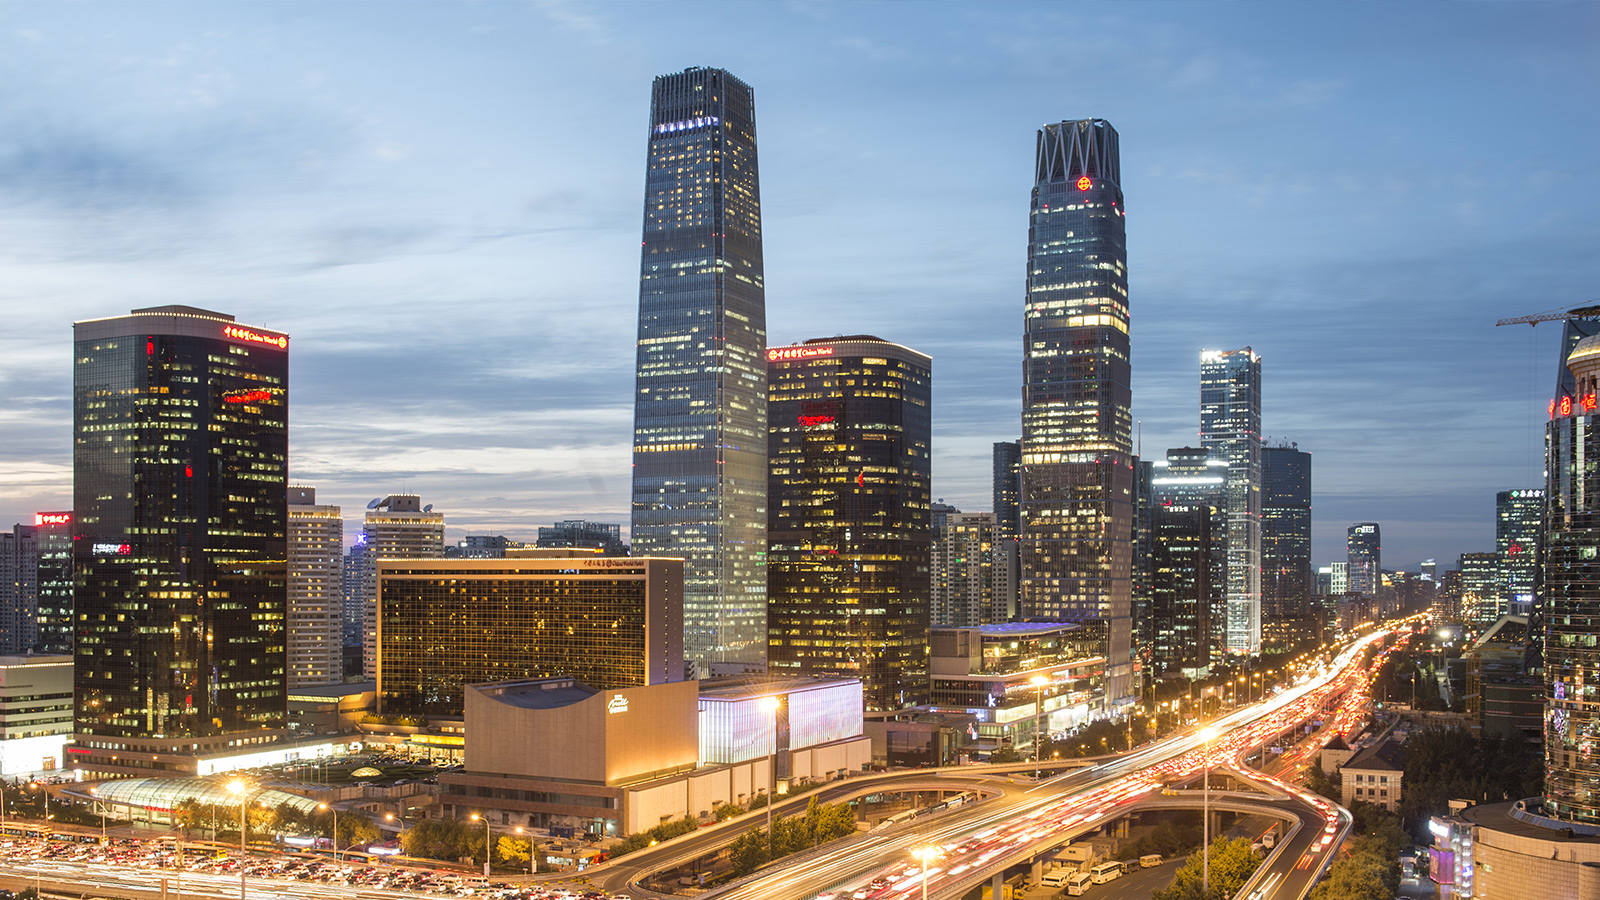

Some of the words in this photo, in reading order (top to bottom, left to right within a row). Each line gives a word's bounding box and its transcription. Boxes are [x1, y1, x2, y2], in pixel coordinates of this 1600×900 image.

[249, 333, 263, 343] China
[263, 335, 278, 345] World
[817, 347, 833, 355] World
